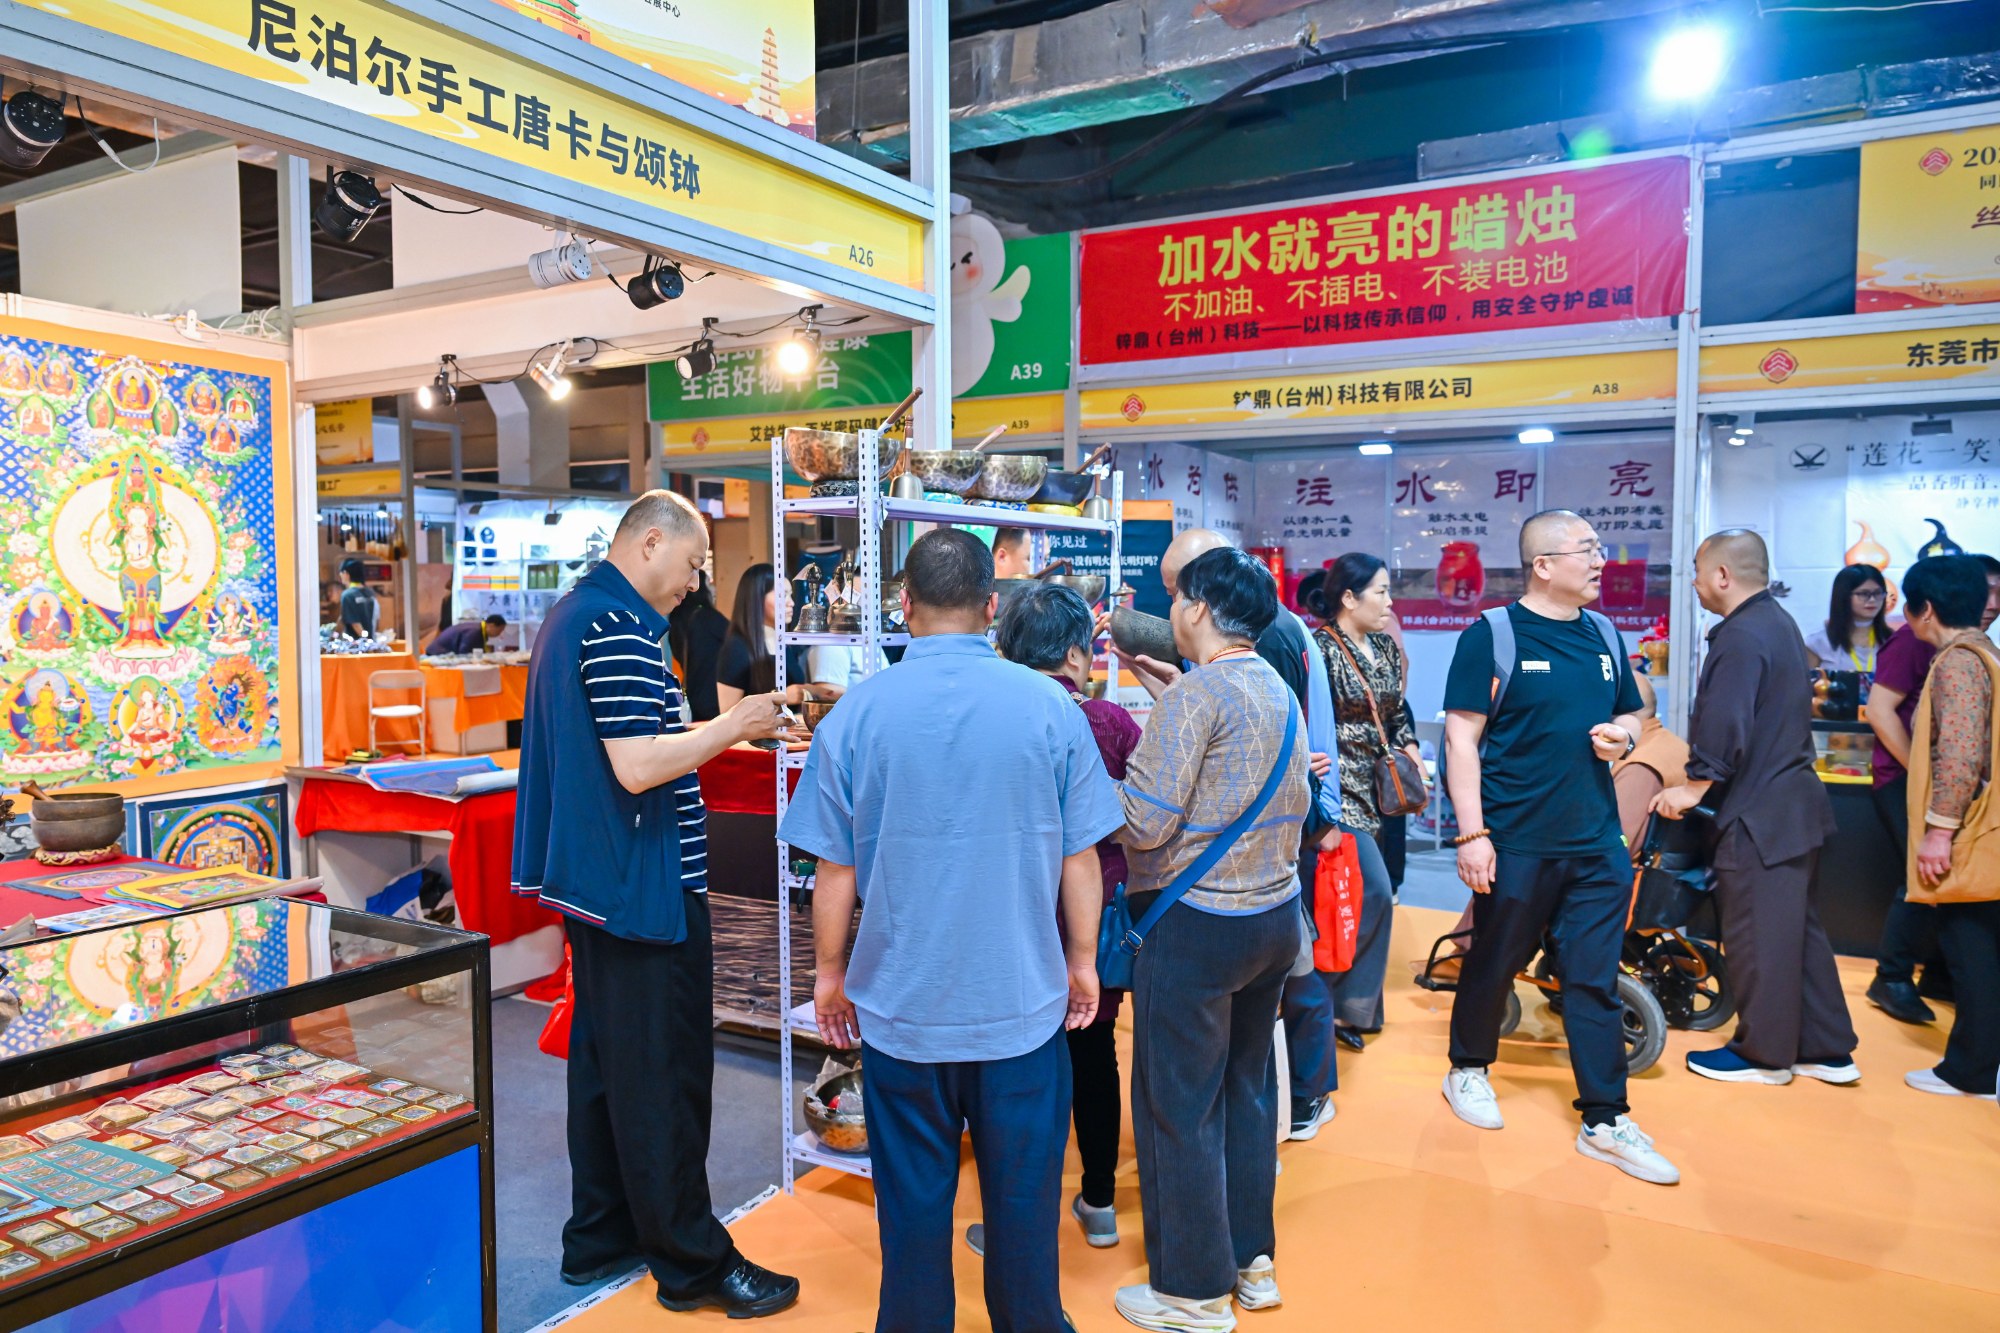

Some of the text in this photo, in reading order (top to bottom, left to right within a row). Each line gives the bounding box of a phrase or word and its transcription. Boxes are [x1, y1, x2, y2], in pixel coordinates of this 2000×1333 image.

[247, 0, 701, 200] 尼泊尔手工唐卡与颂钵
[1963, 146, 2000, 168] 20
[1980, 174, 2000, 190] 同
[1157, 184, 1578, 288] 加水就亮的蜡烛
[848, 244, 874, 268] A26
[1907, 337, 2000, 368] 东莞市
[1010, 362, 1043, 381] A39
[1592, 383, 1619, 395] A38
[1011, 420, 1030, 431] A39
[1845, 437, 2000, 467] “莲花一笑
[1595, 520, 1664, 531] 灯即发愿
[1049, 534, 1088, 549] 你见过
